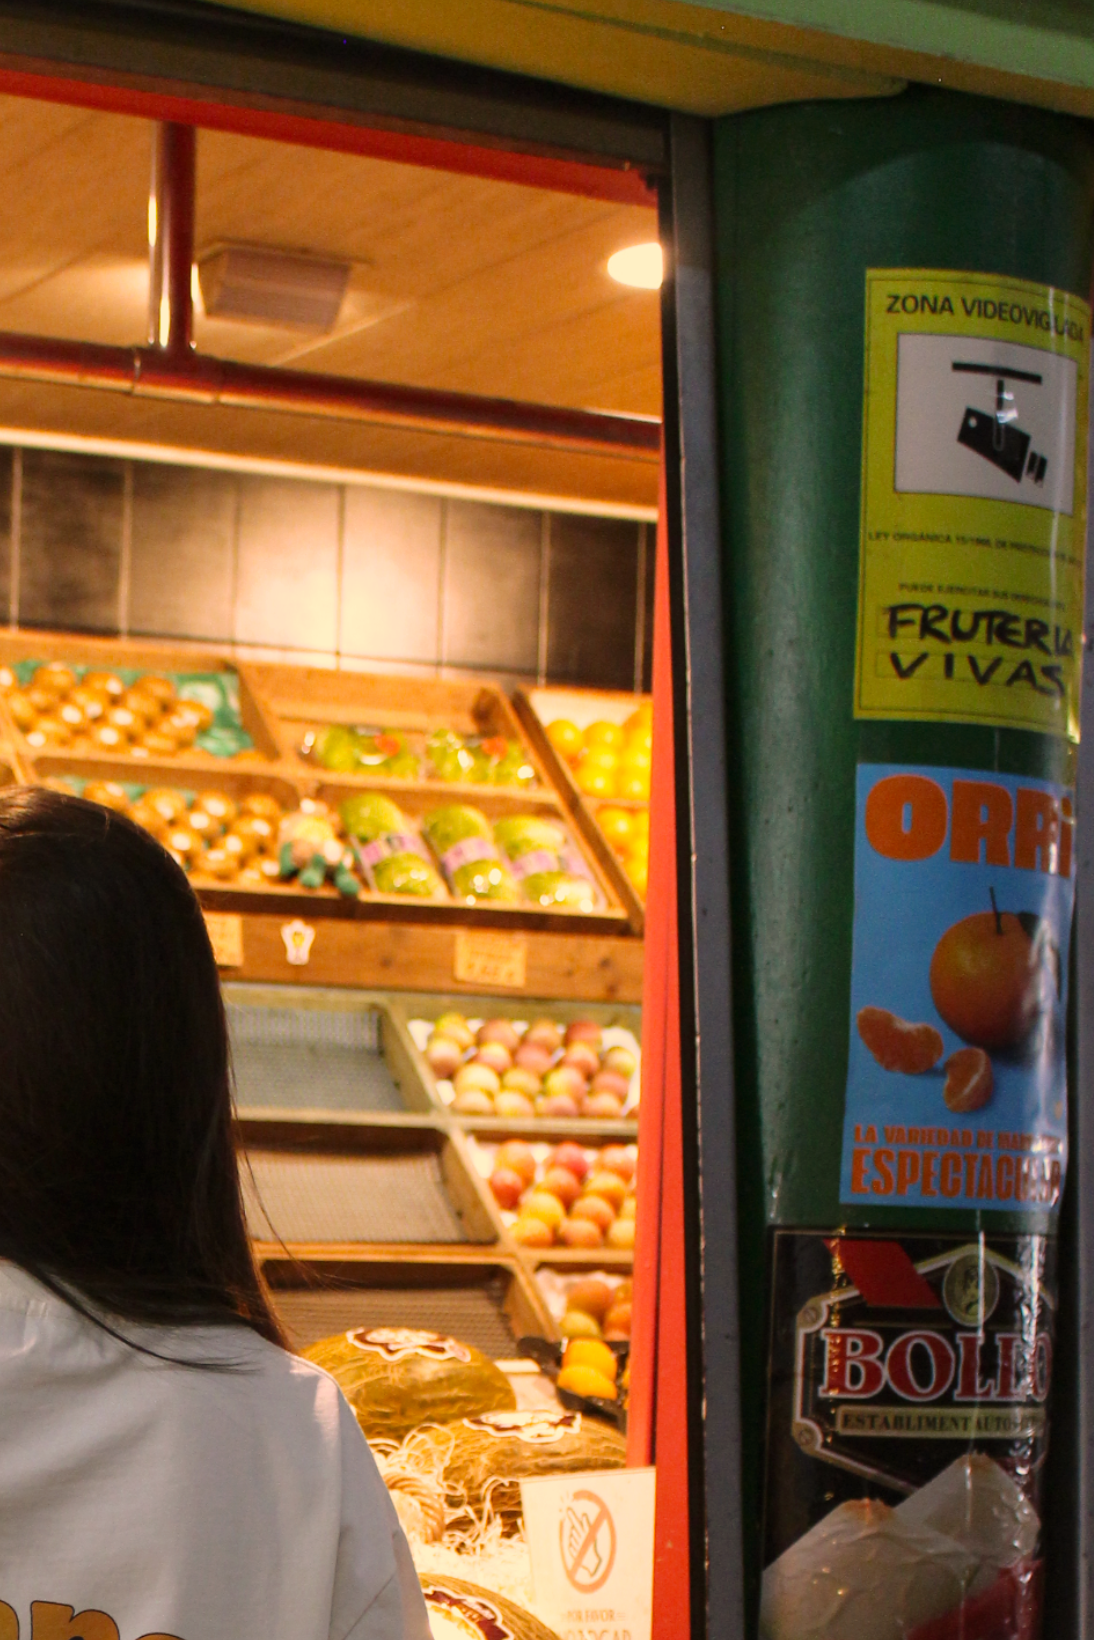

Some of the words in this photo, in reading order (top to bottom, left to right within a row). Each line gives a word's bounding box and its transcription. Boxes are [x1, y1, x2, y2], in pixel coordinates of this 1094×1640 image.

[886, 294, 955, 316] ZONA
[962, 296, 1084, 342] VIDEOVIGLADA
[890, 652, 1065, 697] VIVAS
[854, 1124, 877, 1143] LA
[885, 1126, 973, 1147] VARIEDAD
[977, 1129, 993, 1149] DE
